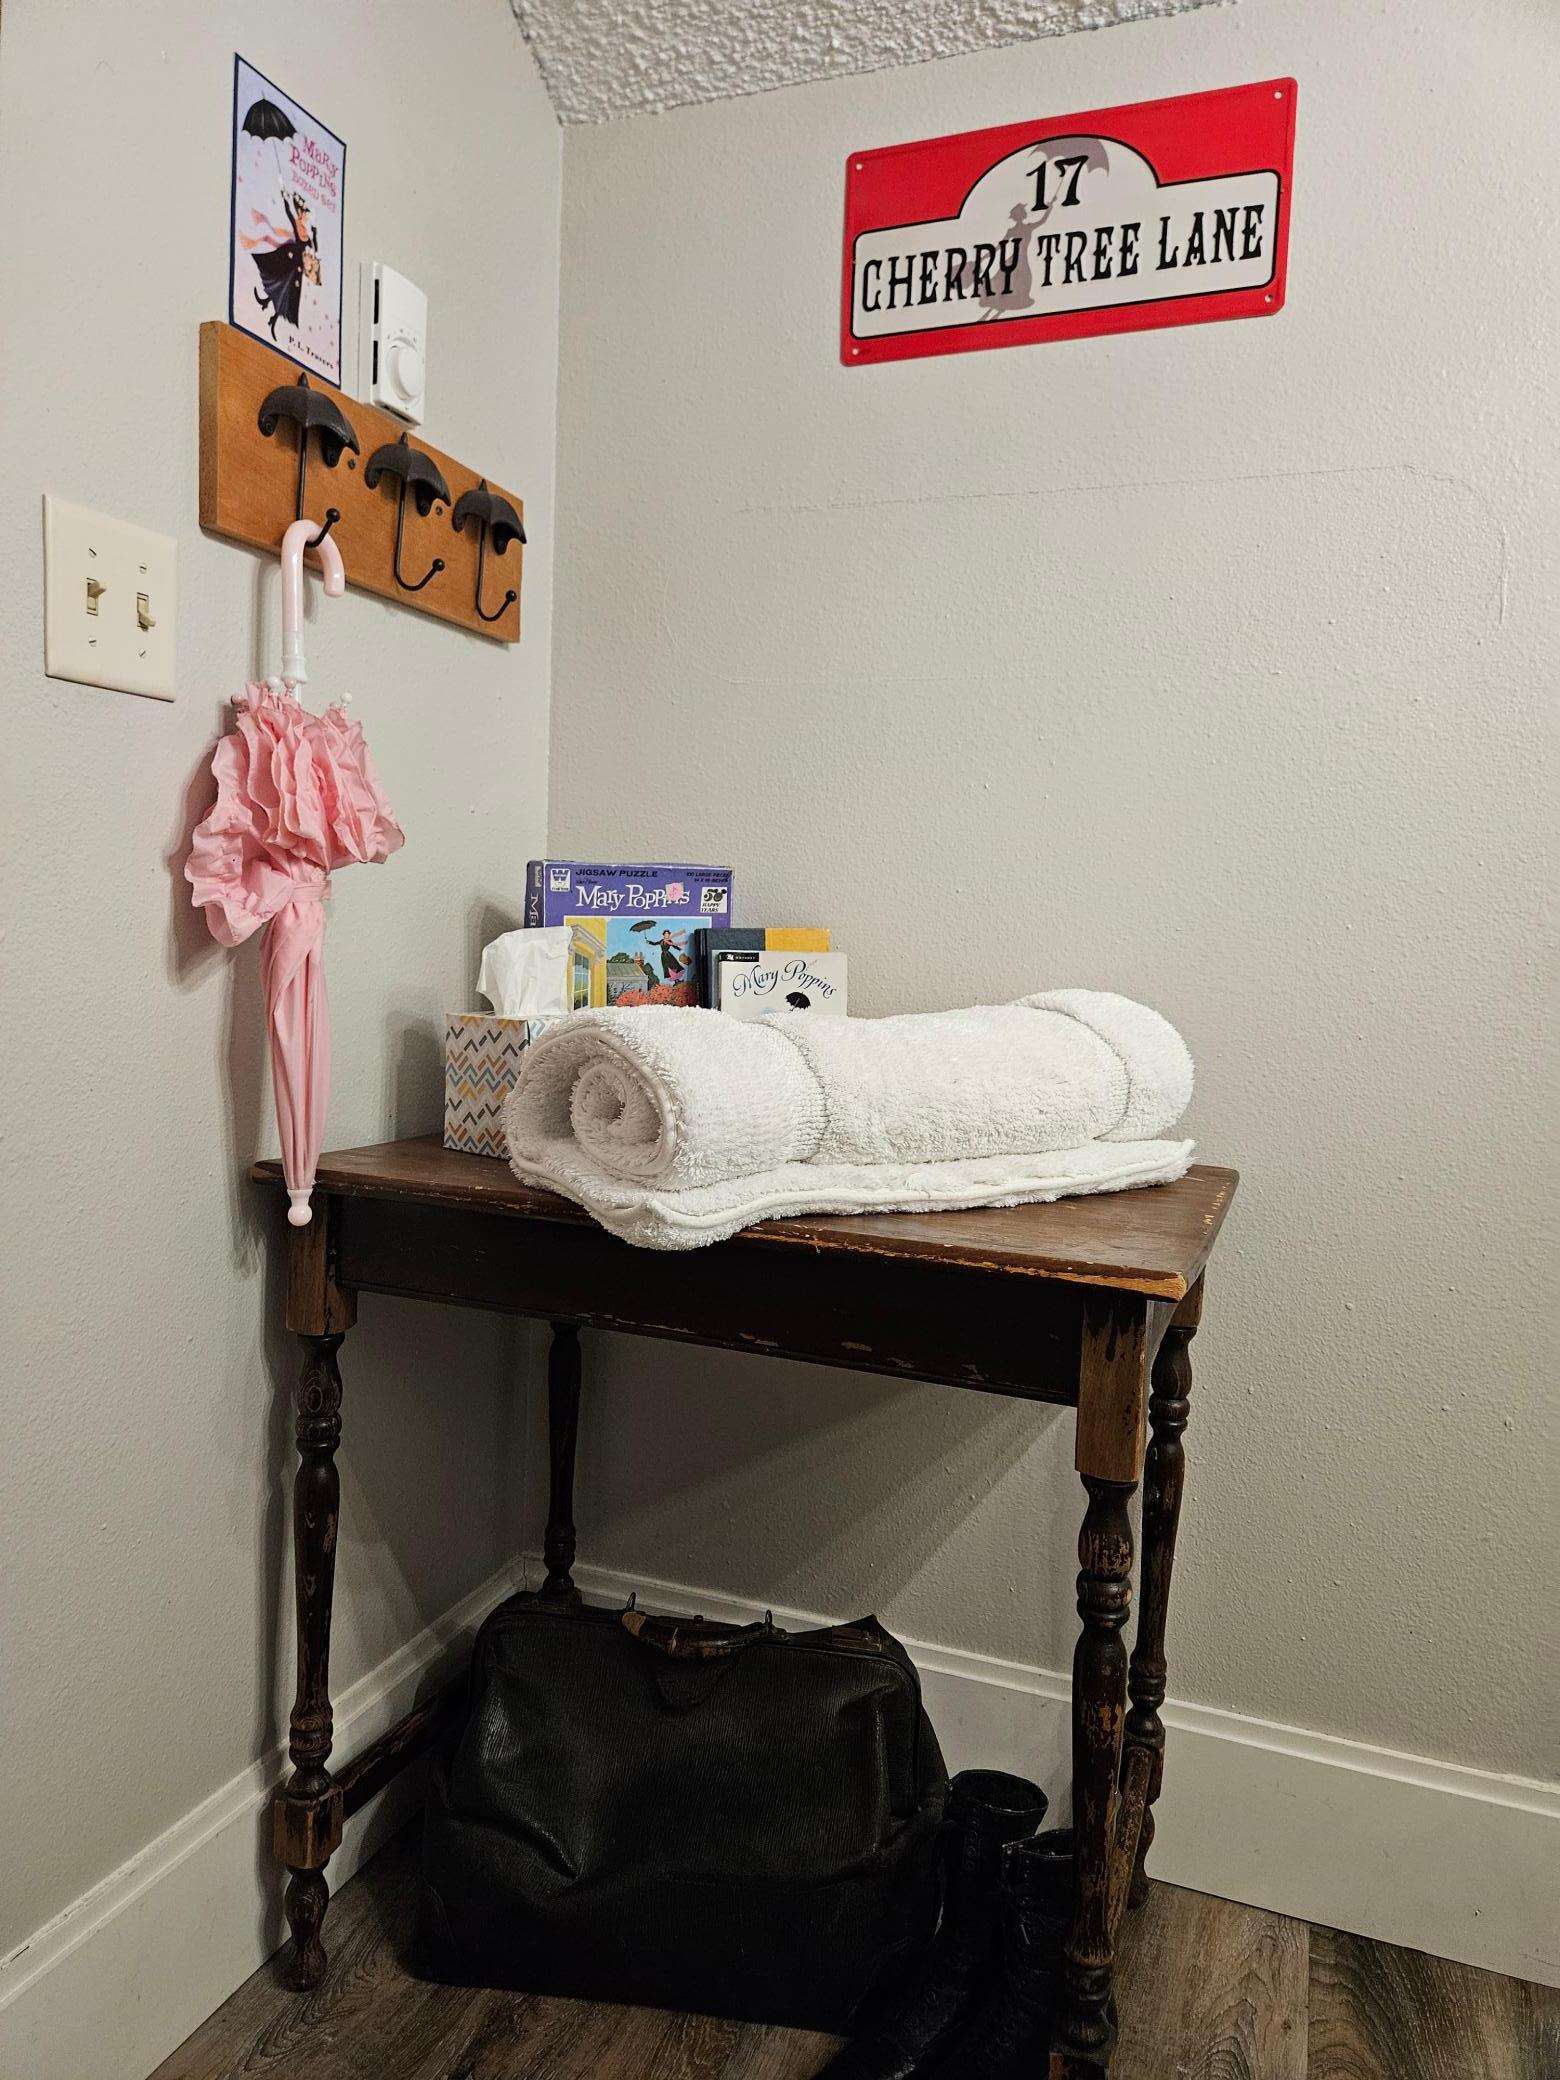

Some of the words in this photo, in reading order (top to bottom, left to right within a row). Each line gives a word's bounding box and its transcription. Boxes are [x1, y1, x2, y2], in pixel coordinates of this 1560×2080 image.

[1026, 155, 1089, 212] 17
[862, 237, 1023, 313] CHERRY
[1037, 222, 1141, 287] TREE
[1156, 204, 1265, 271] LANE
[575, 868, 617, 877] JIGSAW
[619, 869, 658, 878] PUZZLE
[575, 885, 626, 912] Mary
[625, 884, 690, 910] Poppis
[732, 964, 779, 998] Mary
[781, 959, 837, 1000] Poppins
